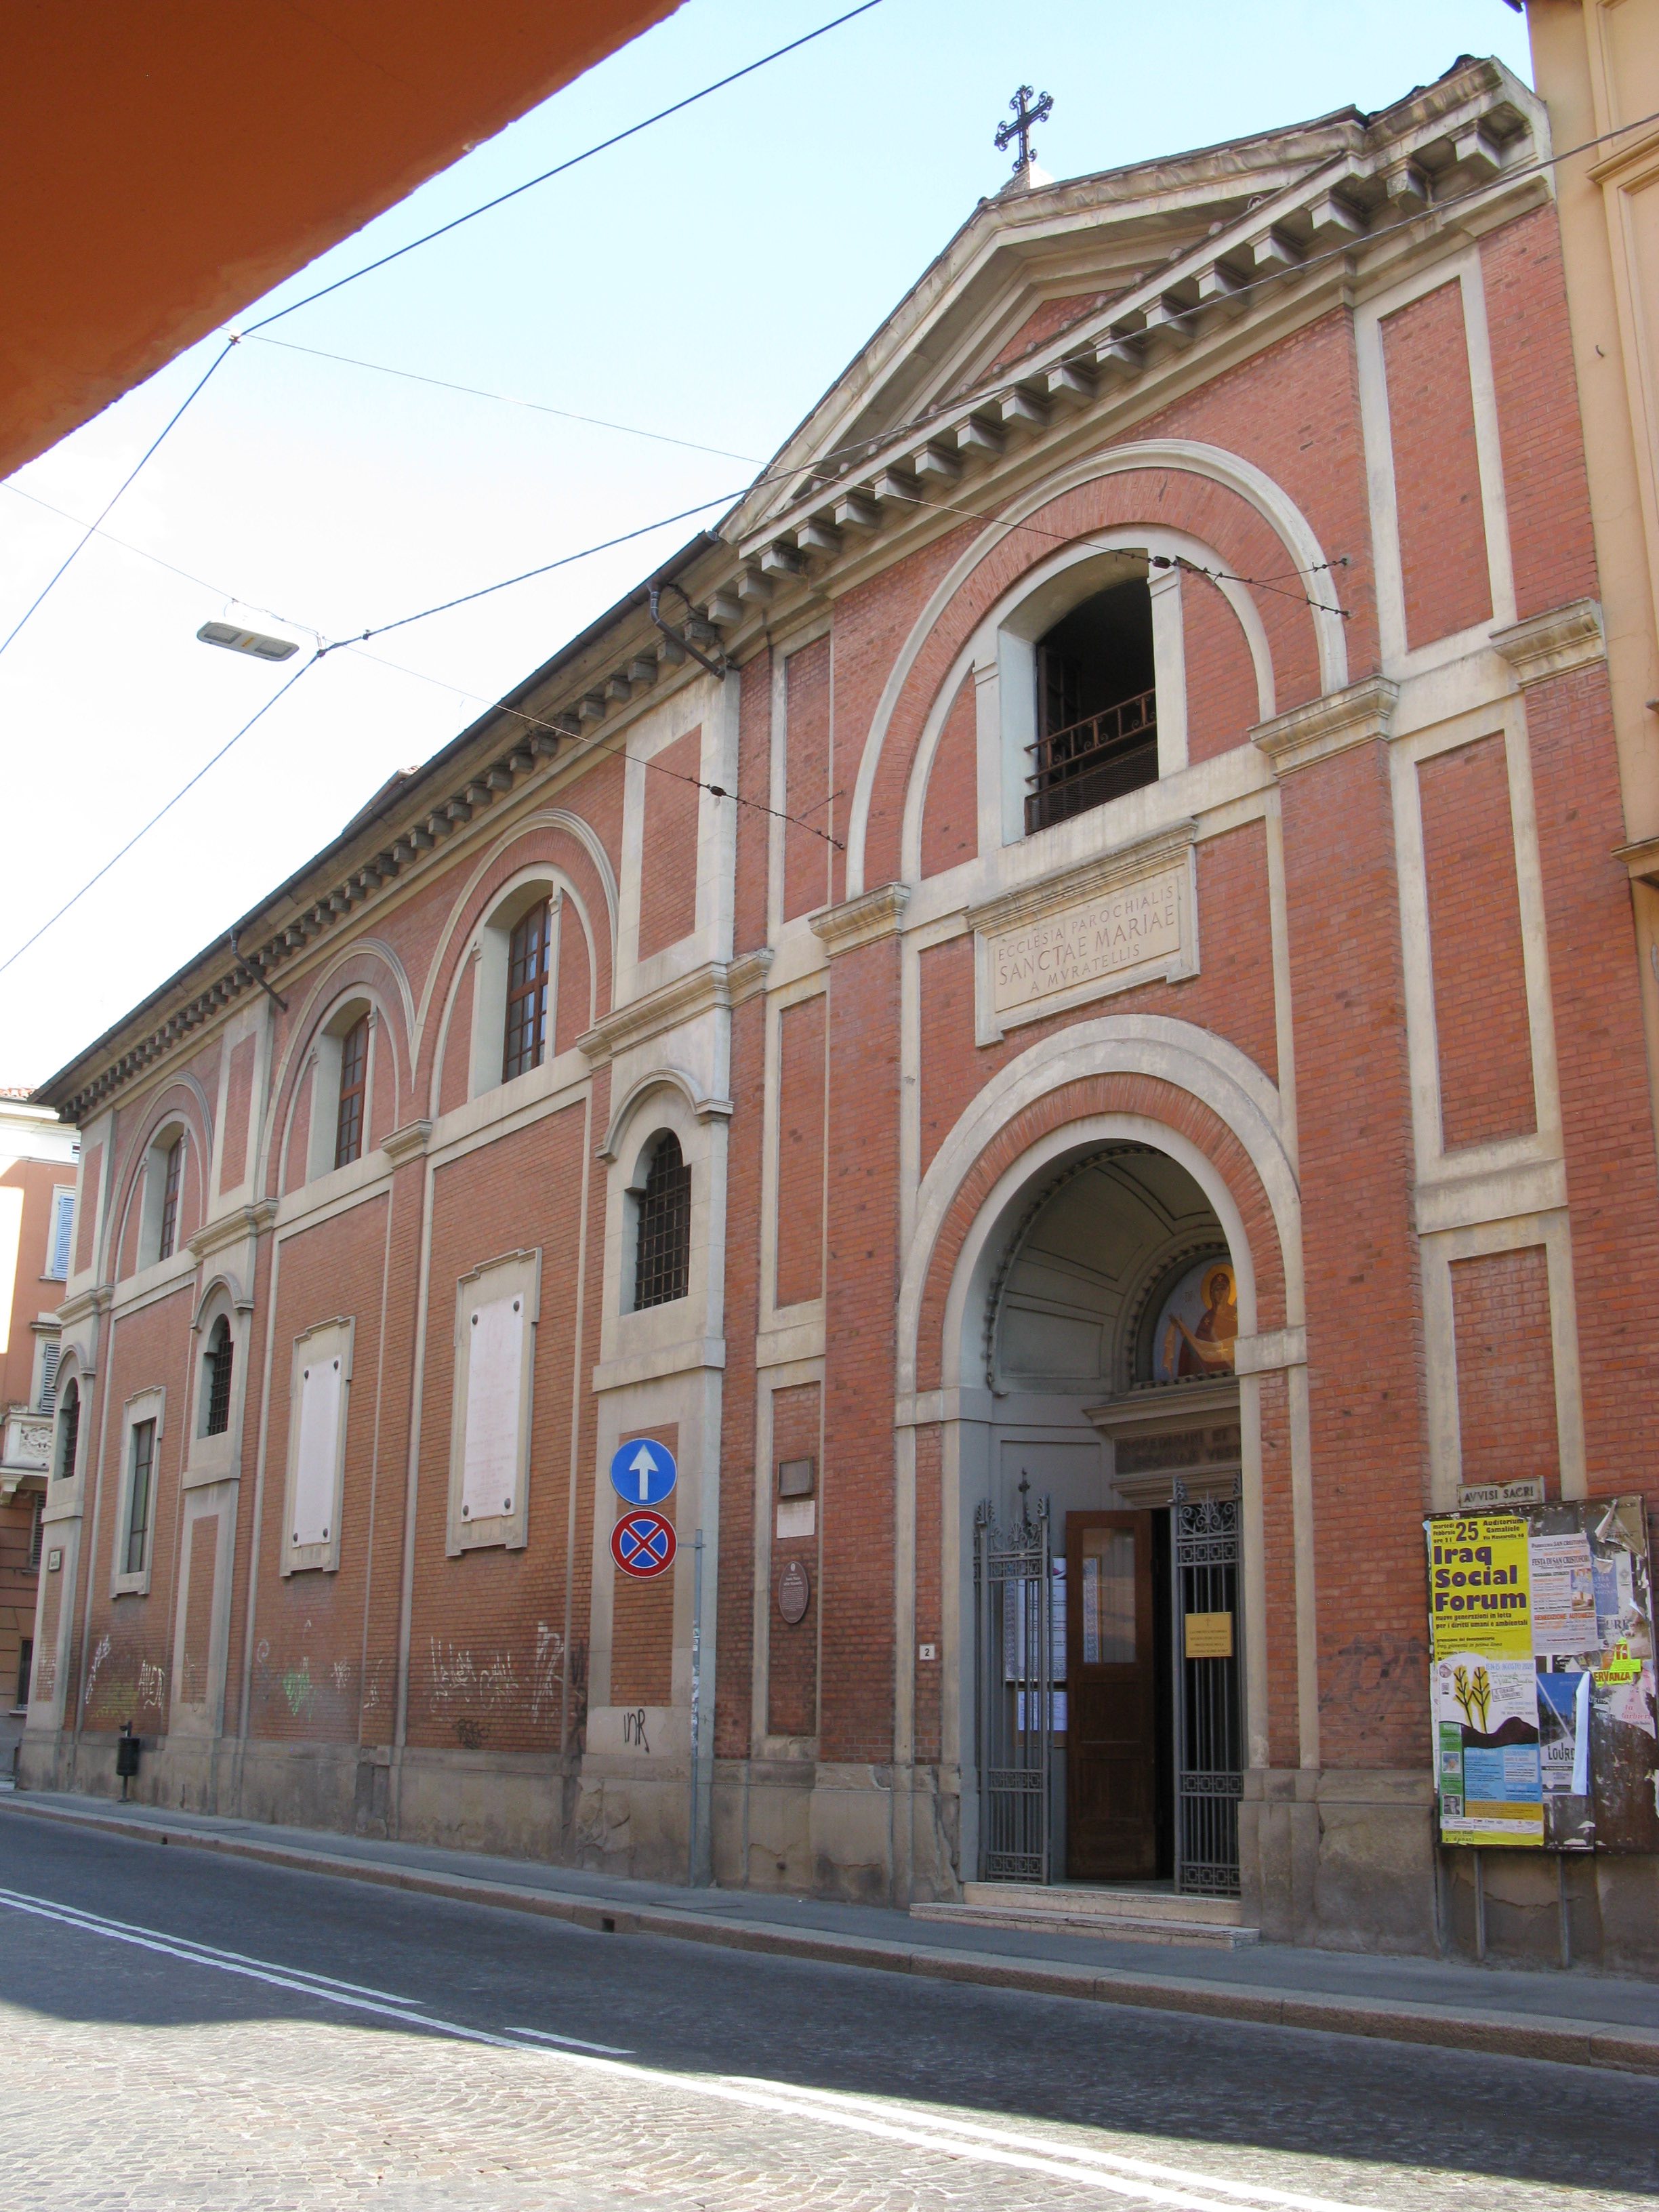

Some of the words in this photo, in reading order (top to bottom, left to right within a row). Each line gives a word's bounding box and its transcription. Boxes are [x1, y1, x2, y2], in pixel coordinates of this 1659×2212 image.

[999, 928, 1064, 961] ECCLESIA
[1072, 886, 1172, 934] PAROCHIALIS
[1000, 937, 1087, 985] SANCTAE
[1096, 904, 1174, 949] MARIAE
[1031, 981, 1040, 994] A
[1048, 944, 1139, 987] MVRATELLIS
[1464, 1490, 1498, 1502] AVVISI
[1503, 1486, 1534, 1498] SACRI
[1456, 1521, 1479, 1542] 25
[1434, 1546, 1492, 1565] Iraq
[1435, 1565, 1517, 1588] Social
[1435, 1593, 1526, 1612] Forum
[924, 1648, 930, 1657] 2
